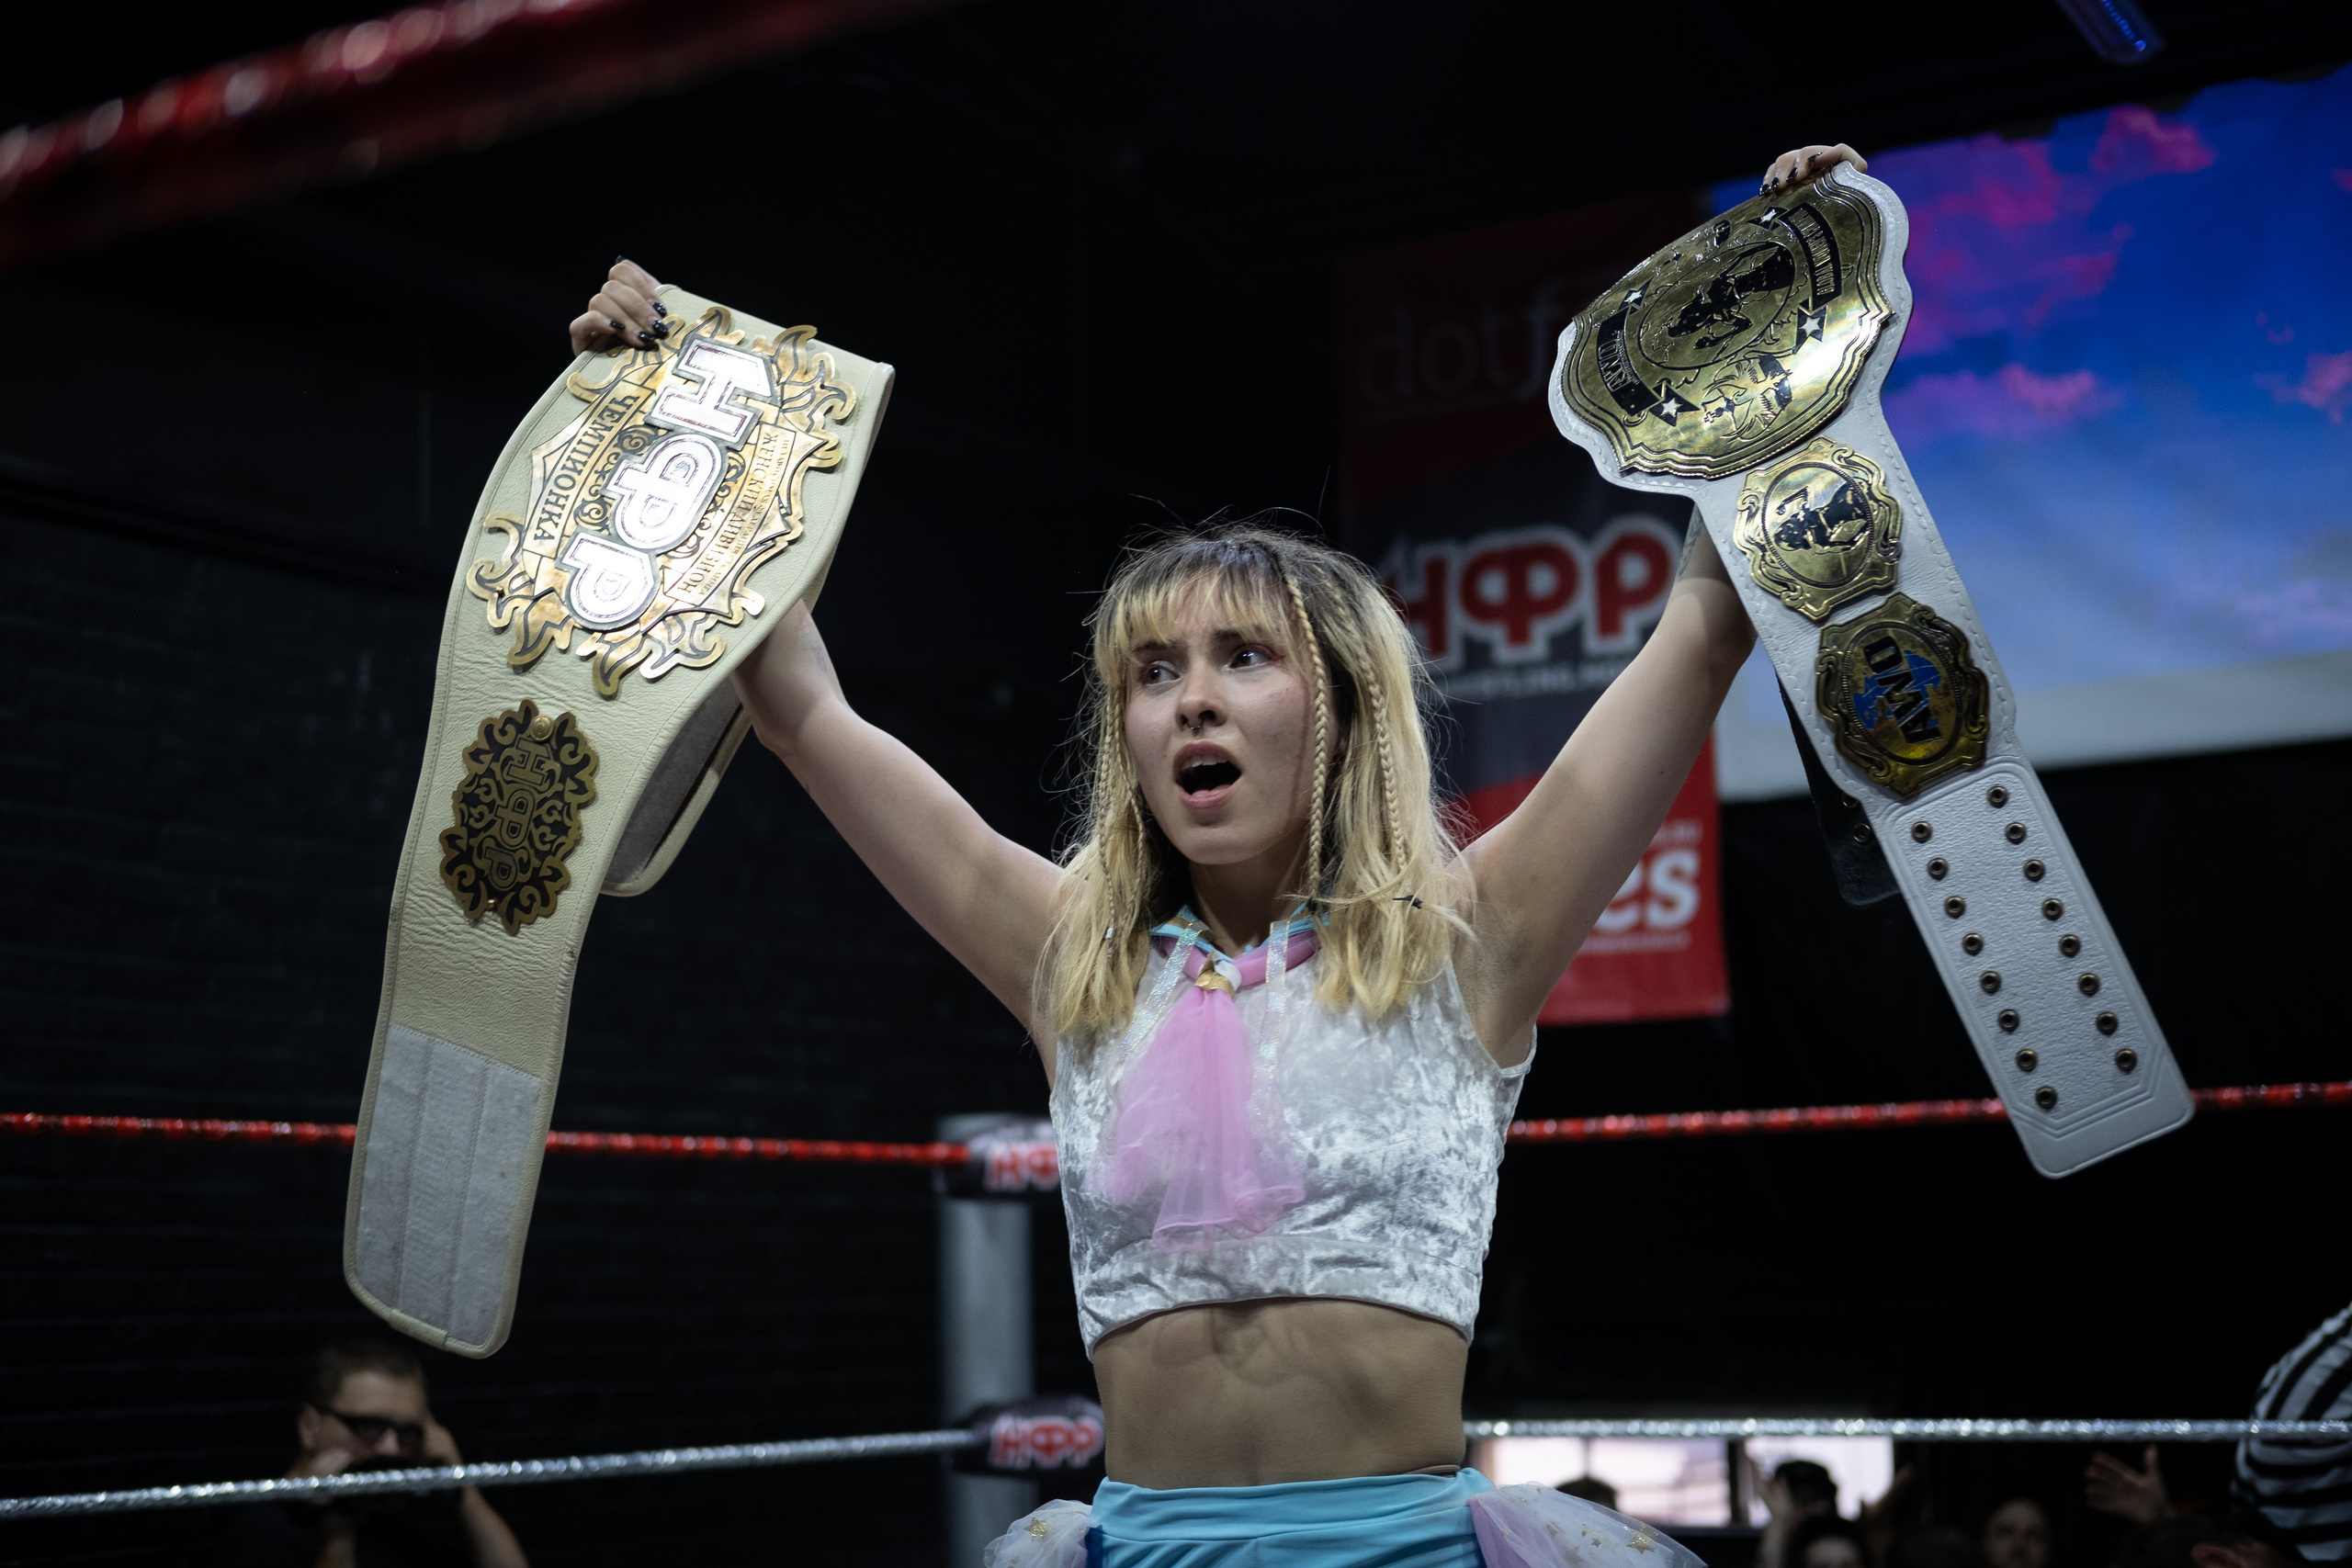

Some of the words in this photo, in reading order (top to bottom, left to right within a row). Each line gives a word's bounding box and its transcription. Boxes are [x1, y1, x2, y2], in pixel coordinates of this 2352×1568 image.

[1815, 262, 1835, 296] GLOBAL
[533, 395, 640, 541] ЧЕМПИОНКА
[557, 335, 779, 628] НФР
[739, 432, 779, 512] ЖЕНСКИЙ
[678, 511, 746, 593] ДИВИЗИОН
[1862, 635, 1942, 744] AWO
[483, 736, 552, 892] НФР
[984, 1139, 1060, 1192] НФ
